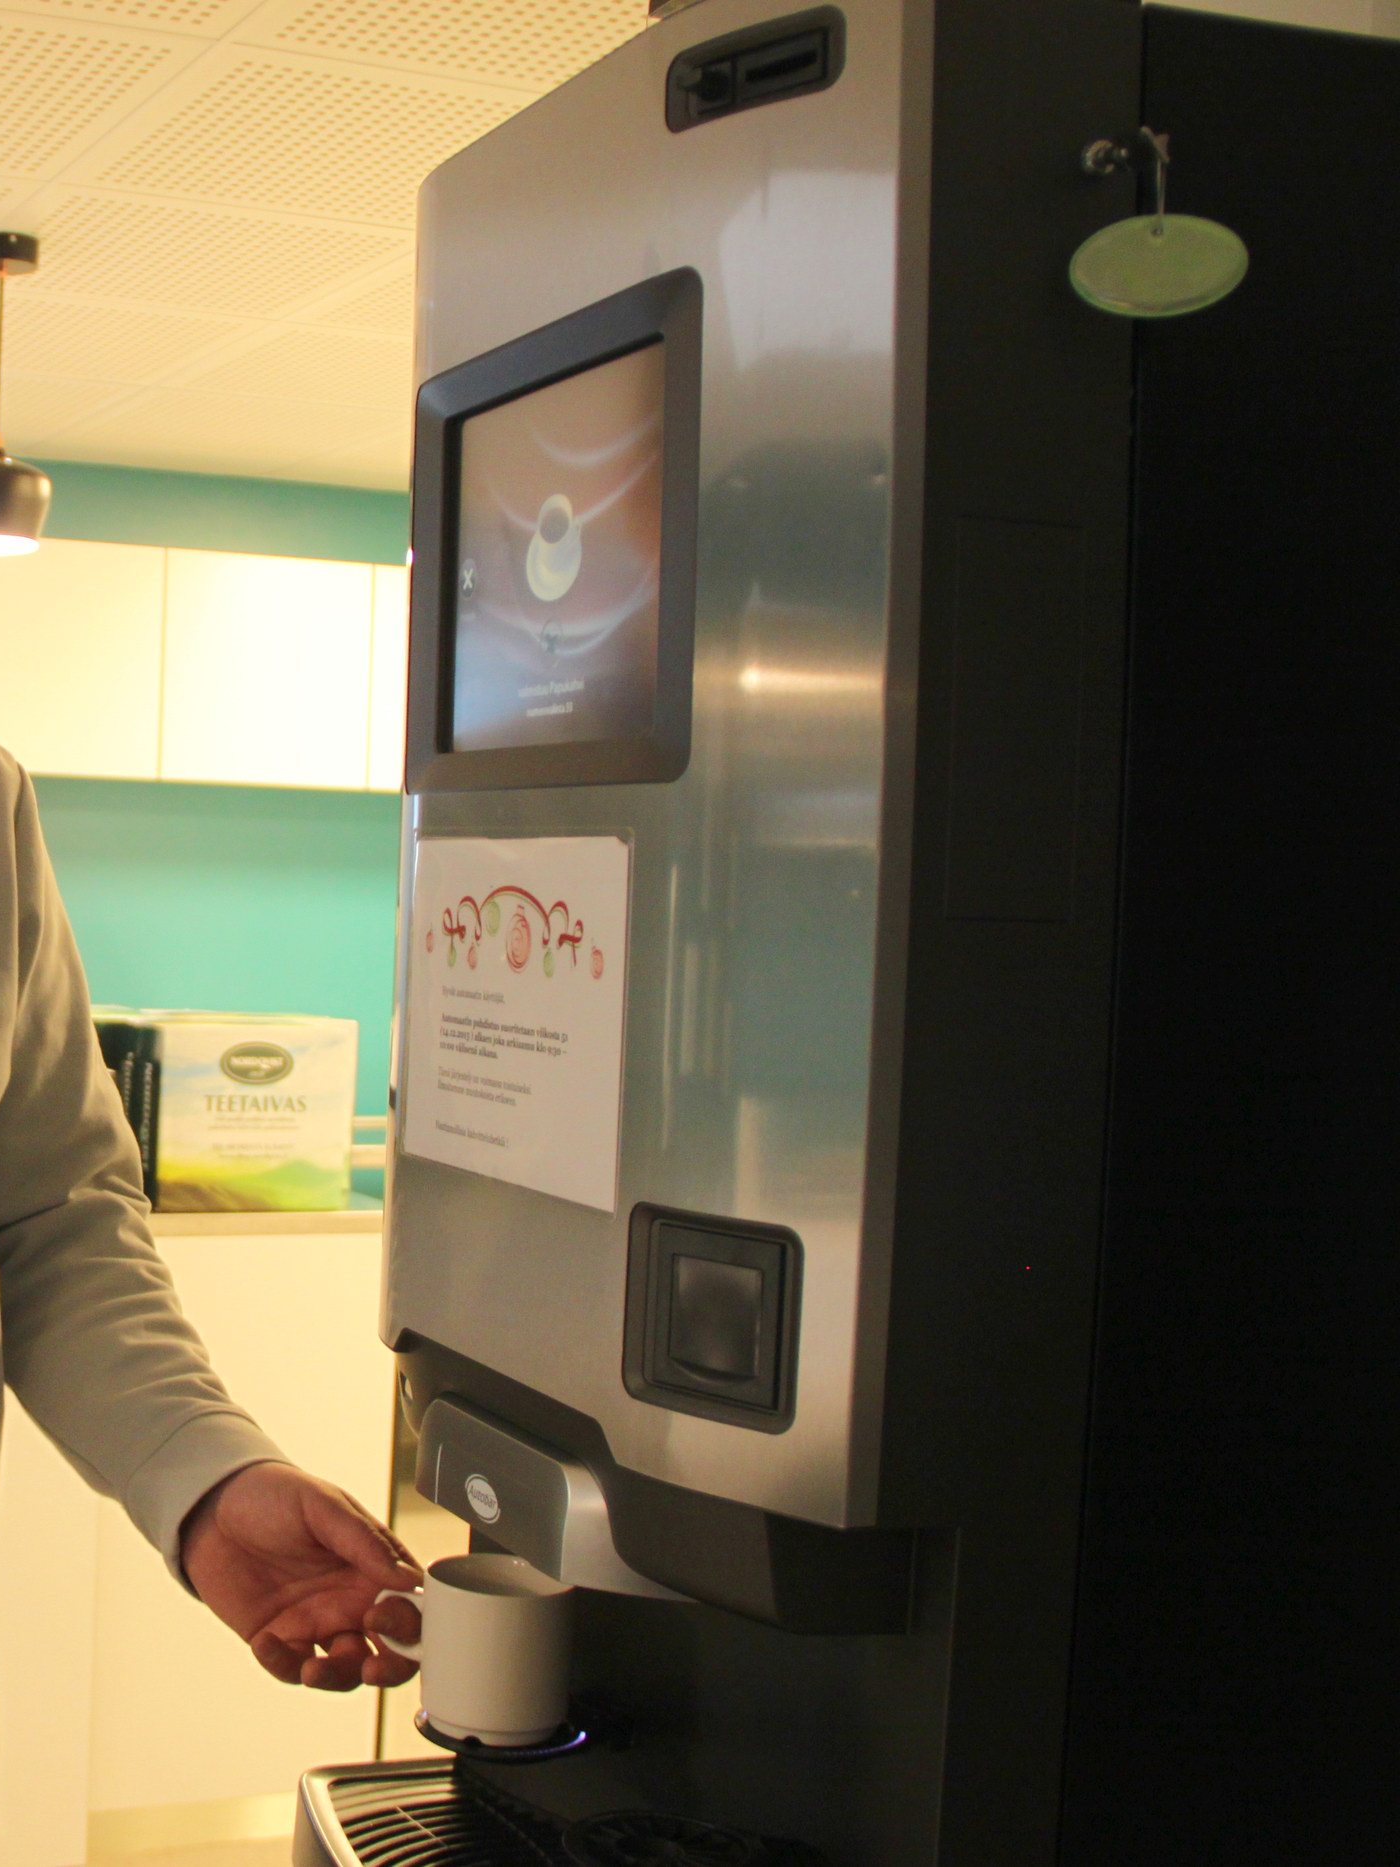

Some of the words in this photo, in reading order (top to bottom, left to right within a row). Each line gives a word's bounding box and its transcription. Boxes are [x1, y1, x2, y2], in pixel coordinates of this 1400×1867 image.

[441, 1012, 472, 1026] Automaatin
[501, 1023, 535, 1036] suoritetaan
[536, 1040, 547, 1052] klo
[204, 1095, 308, 1113] TEETAIVAS
[468, 1485, 496, 1509] Autobar
